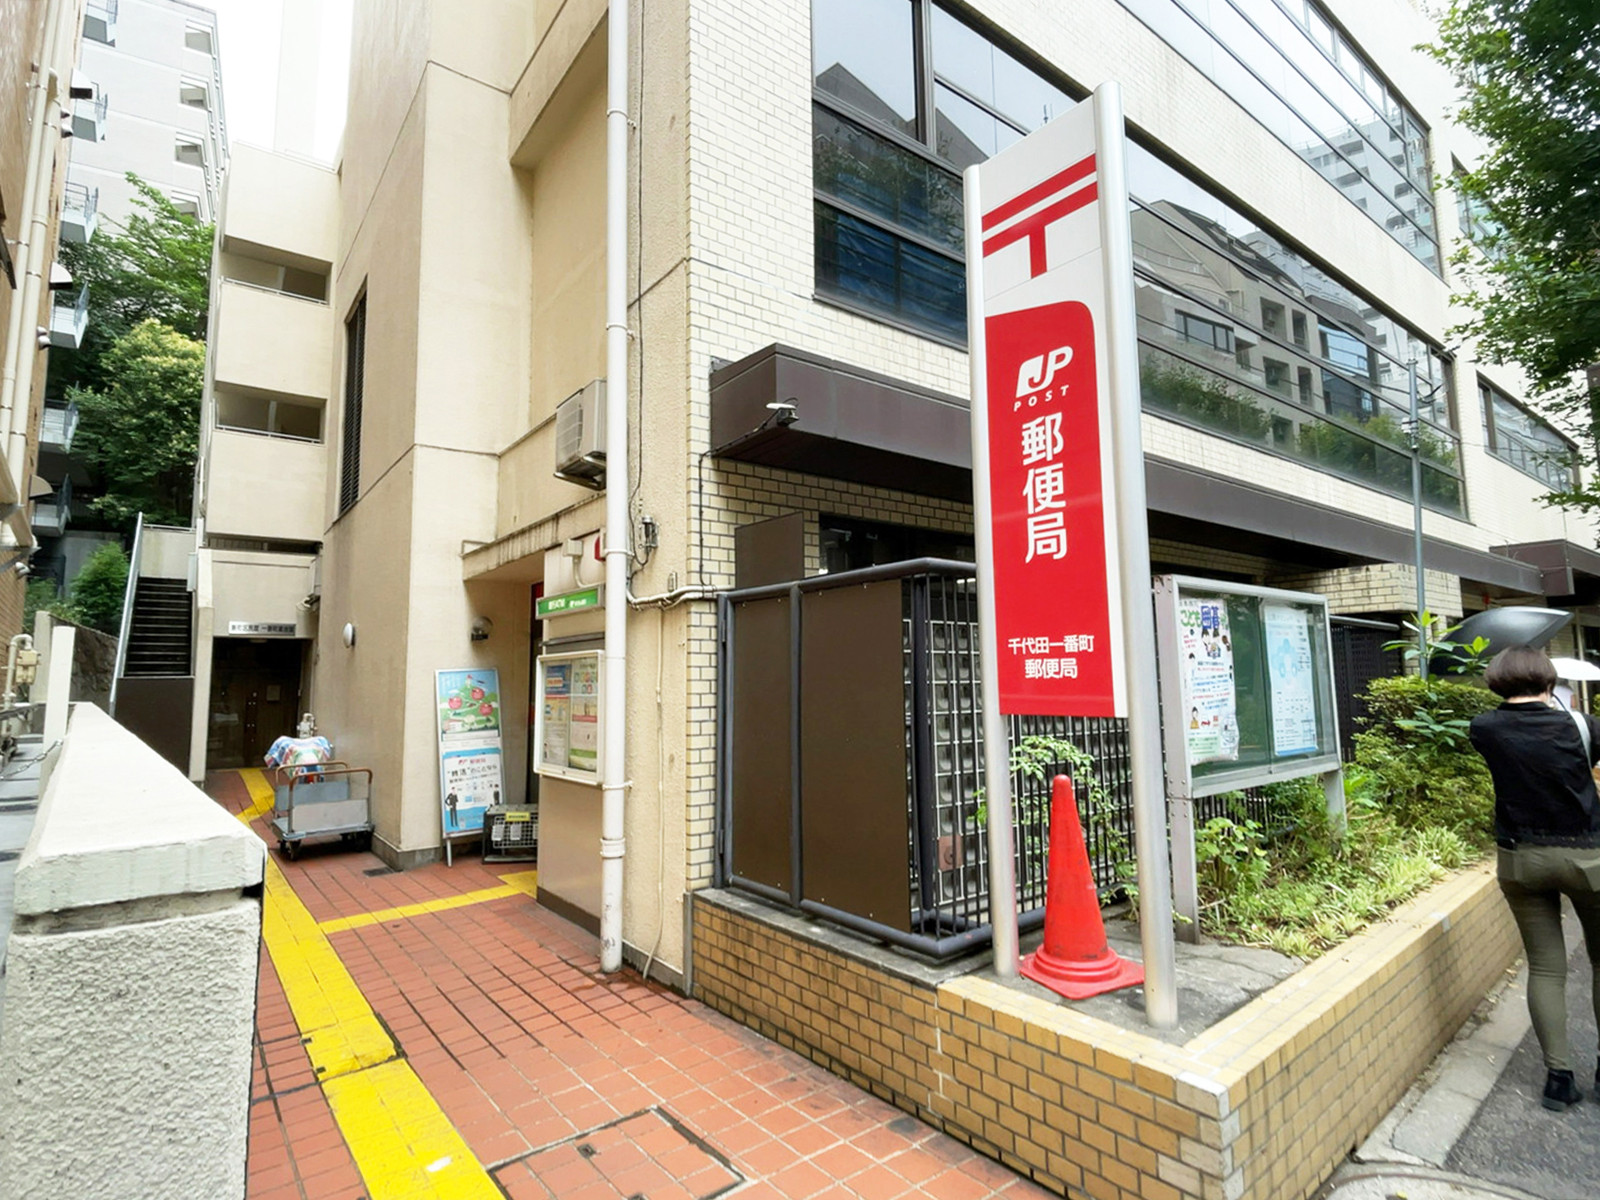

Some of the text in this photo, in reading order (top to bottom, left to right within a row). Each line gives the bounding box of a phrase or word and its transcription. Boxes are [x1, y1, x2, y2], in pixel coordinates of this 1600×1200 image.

[1015, 346, 1073, 398] JP
[1013, 384, 1069, 412] POST
[1021, 412, 1068, 564] 郵便局
[1008, 634, 1095, 655] 千代田一番町
[1025, 658, 1078, 679] 郵便局
